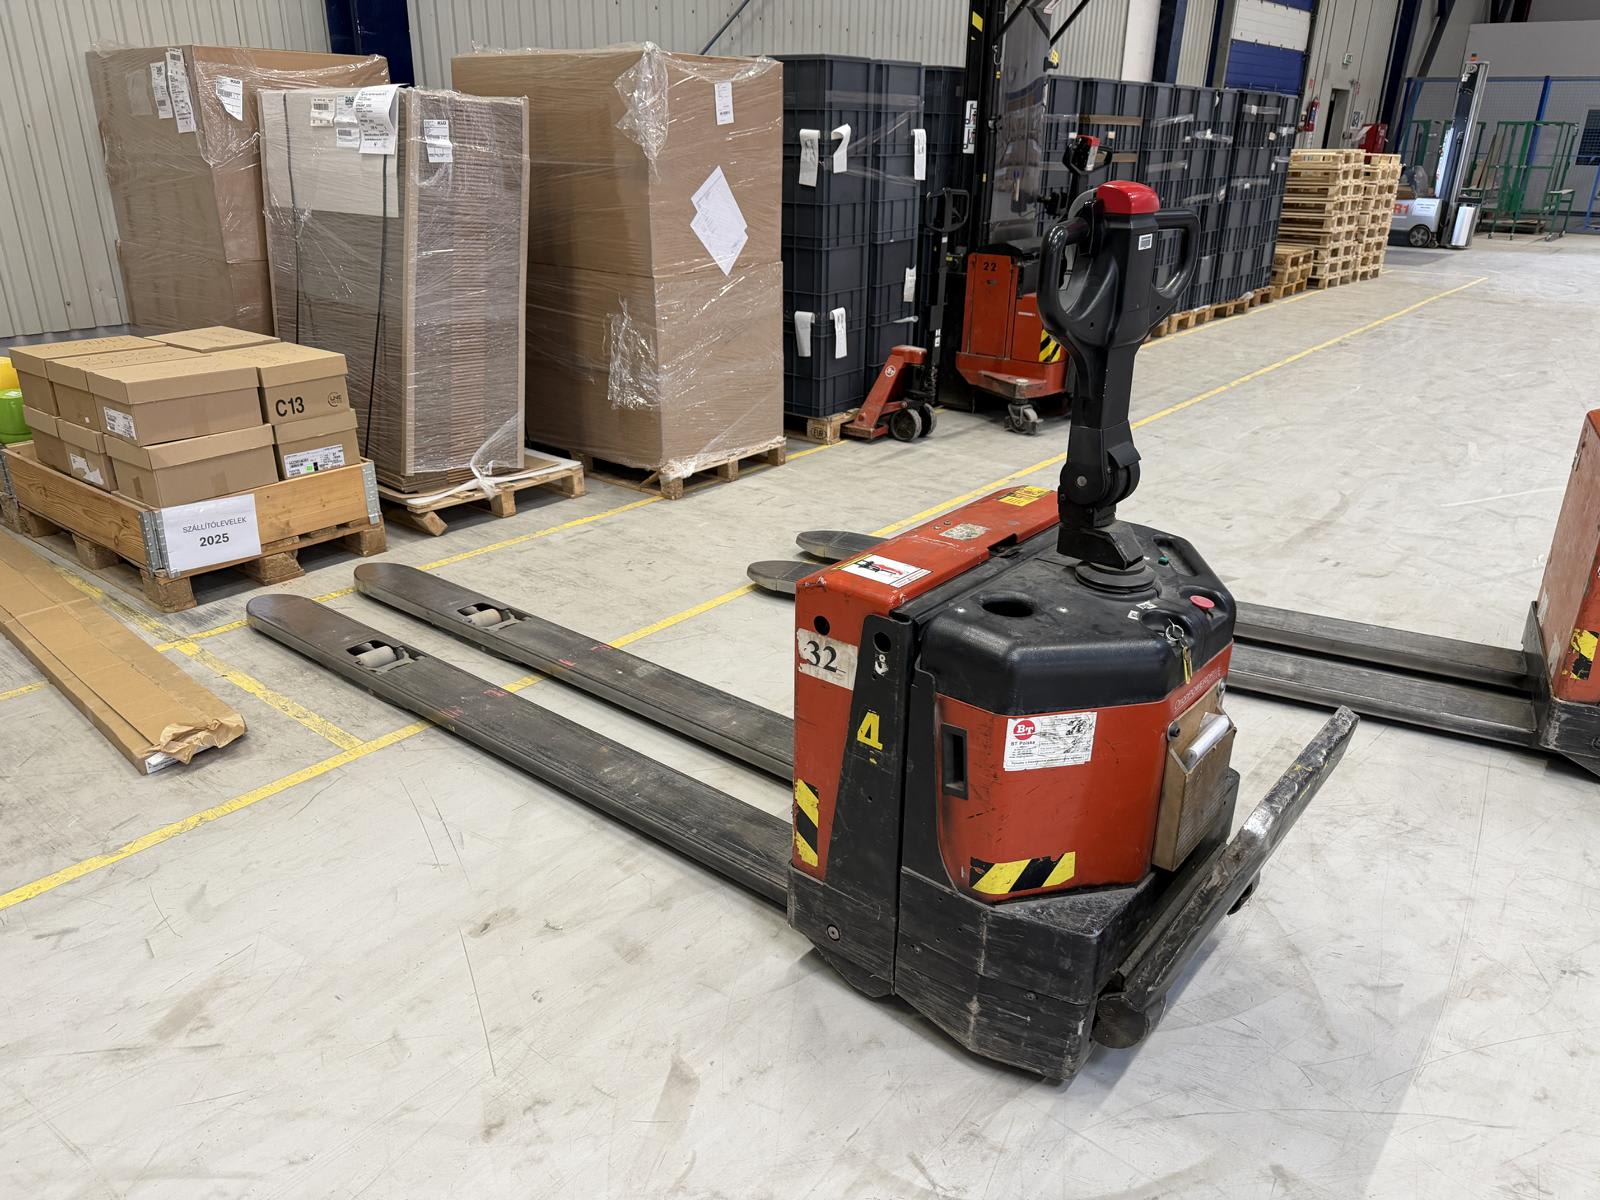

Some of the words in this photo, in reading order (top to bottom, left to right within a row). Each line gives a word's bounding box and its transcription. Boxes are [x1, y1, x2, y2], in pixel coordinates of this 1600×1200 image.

[983, 262, 997, 271] 22
[275, 396, 304, 417] C13
[182, 515, 247, 533] SZÁLLÍTÓLEVELEK
[199, 533, 229, 547] 2025
[803, 640, 838, 672] 32
[857, 709, 883, 750] 4
[1016, 724, 1034, 735] BT
